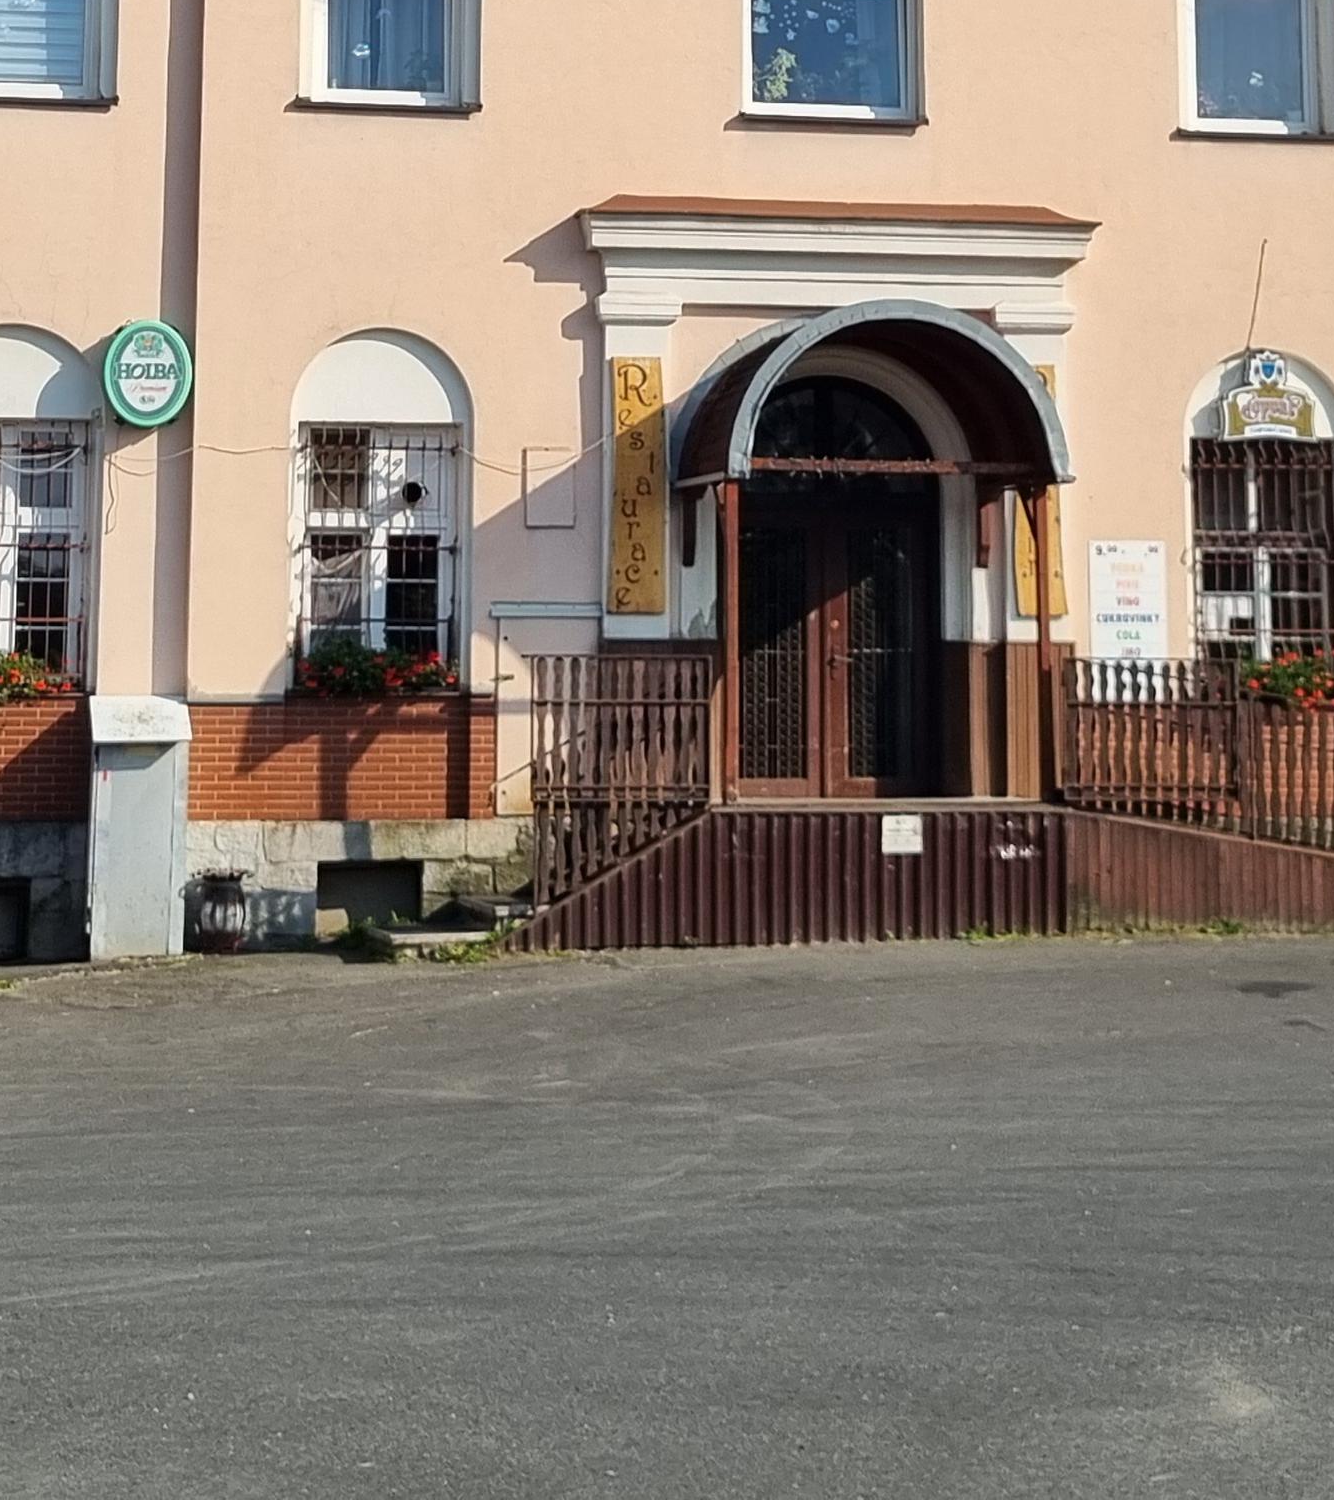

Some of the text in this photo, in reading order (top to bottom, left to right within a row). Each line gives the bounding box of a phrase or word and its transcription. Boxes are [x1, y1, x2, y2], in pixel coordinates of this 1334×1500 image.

[116, 363, 179, 379] HOLBA
[1095, 612, 1160, 623] CUKROVINKY
[1116, 629, 1141, 640] COLA
